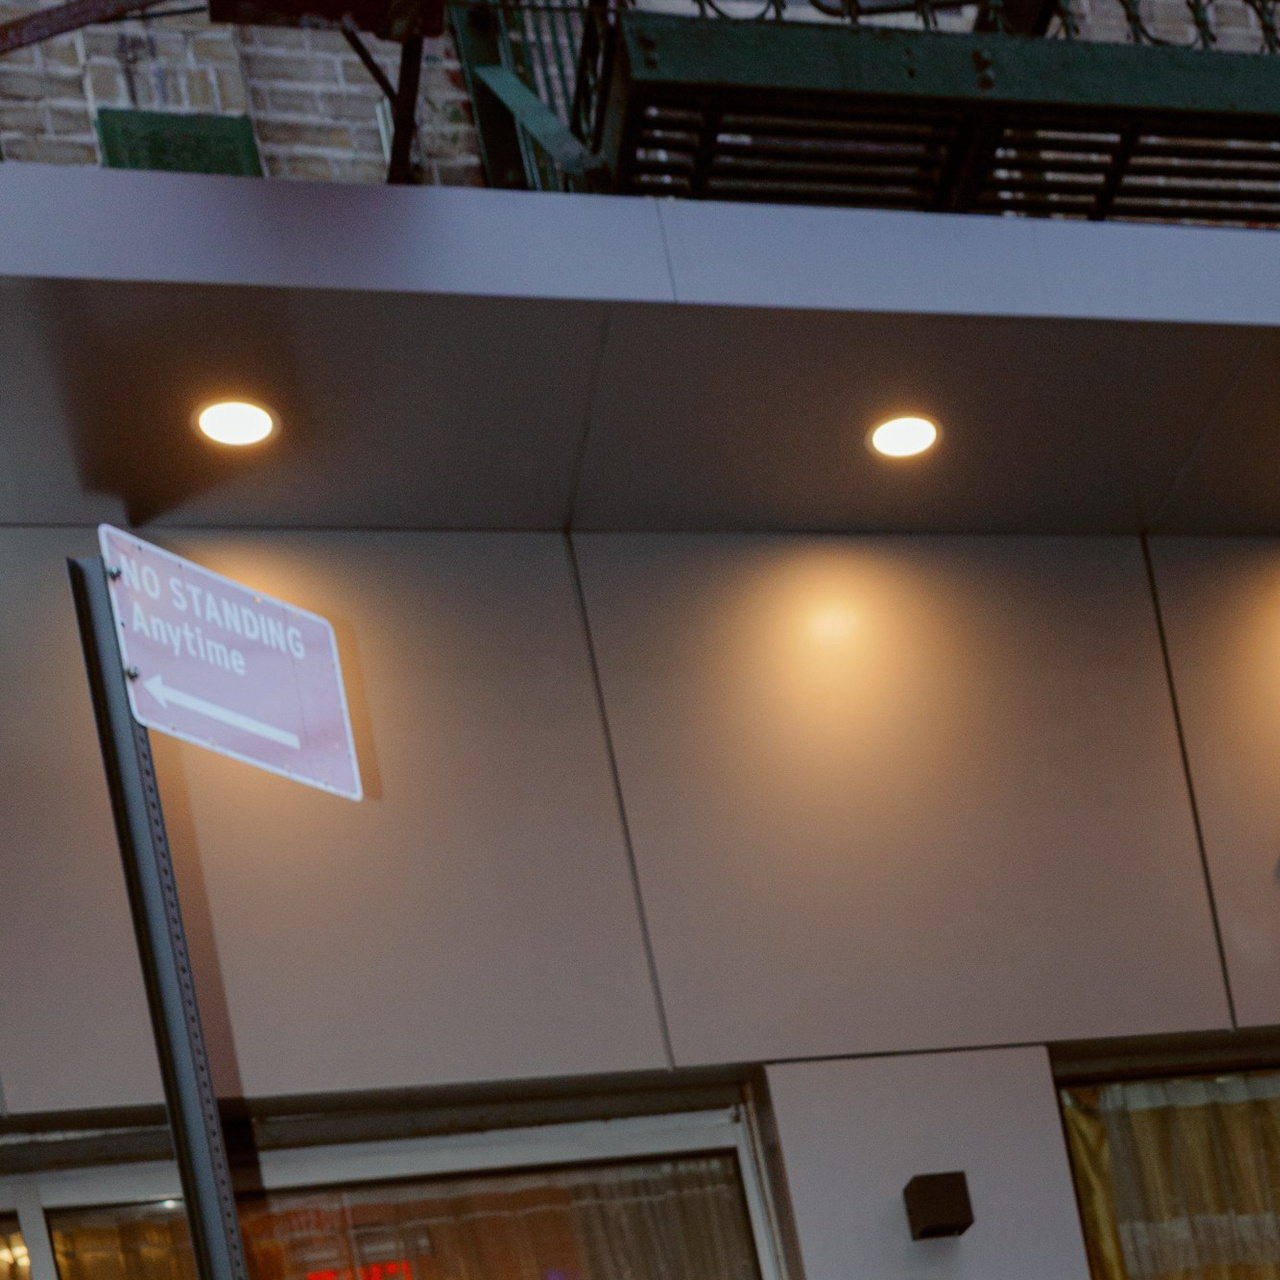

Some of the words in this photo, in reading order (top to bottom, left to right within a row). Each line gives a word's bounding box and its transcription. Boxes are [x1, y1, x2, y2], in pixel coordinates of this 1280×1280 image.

[119, 553, 160, 600] NO
[170, 577, 305, 660] STANDING
[132, 602, 247, 677] Anytime
